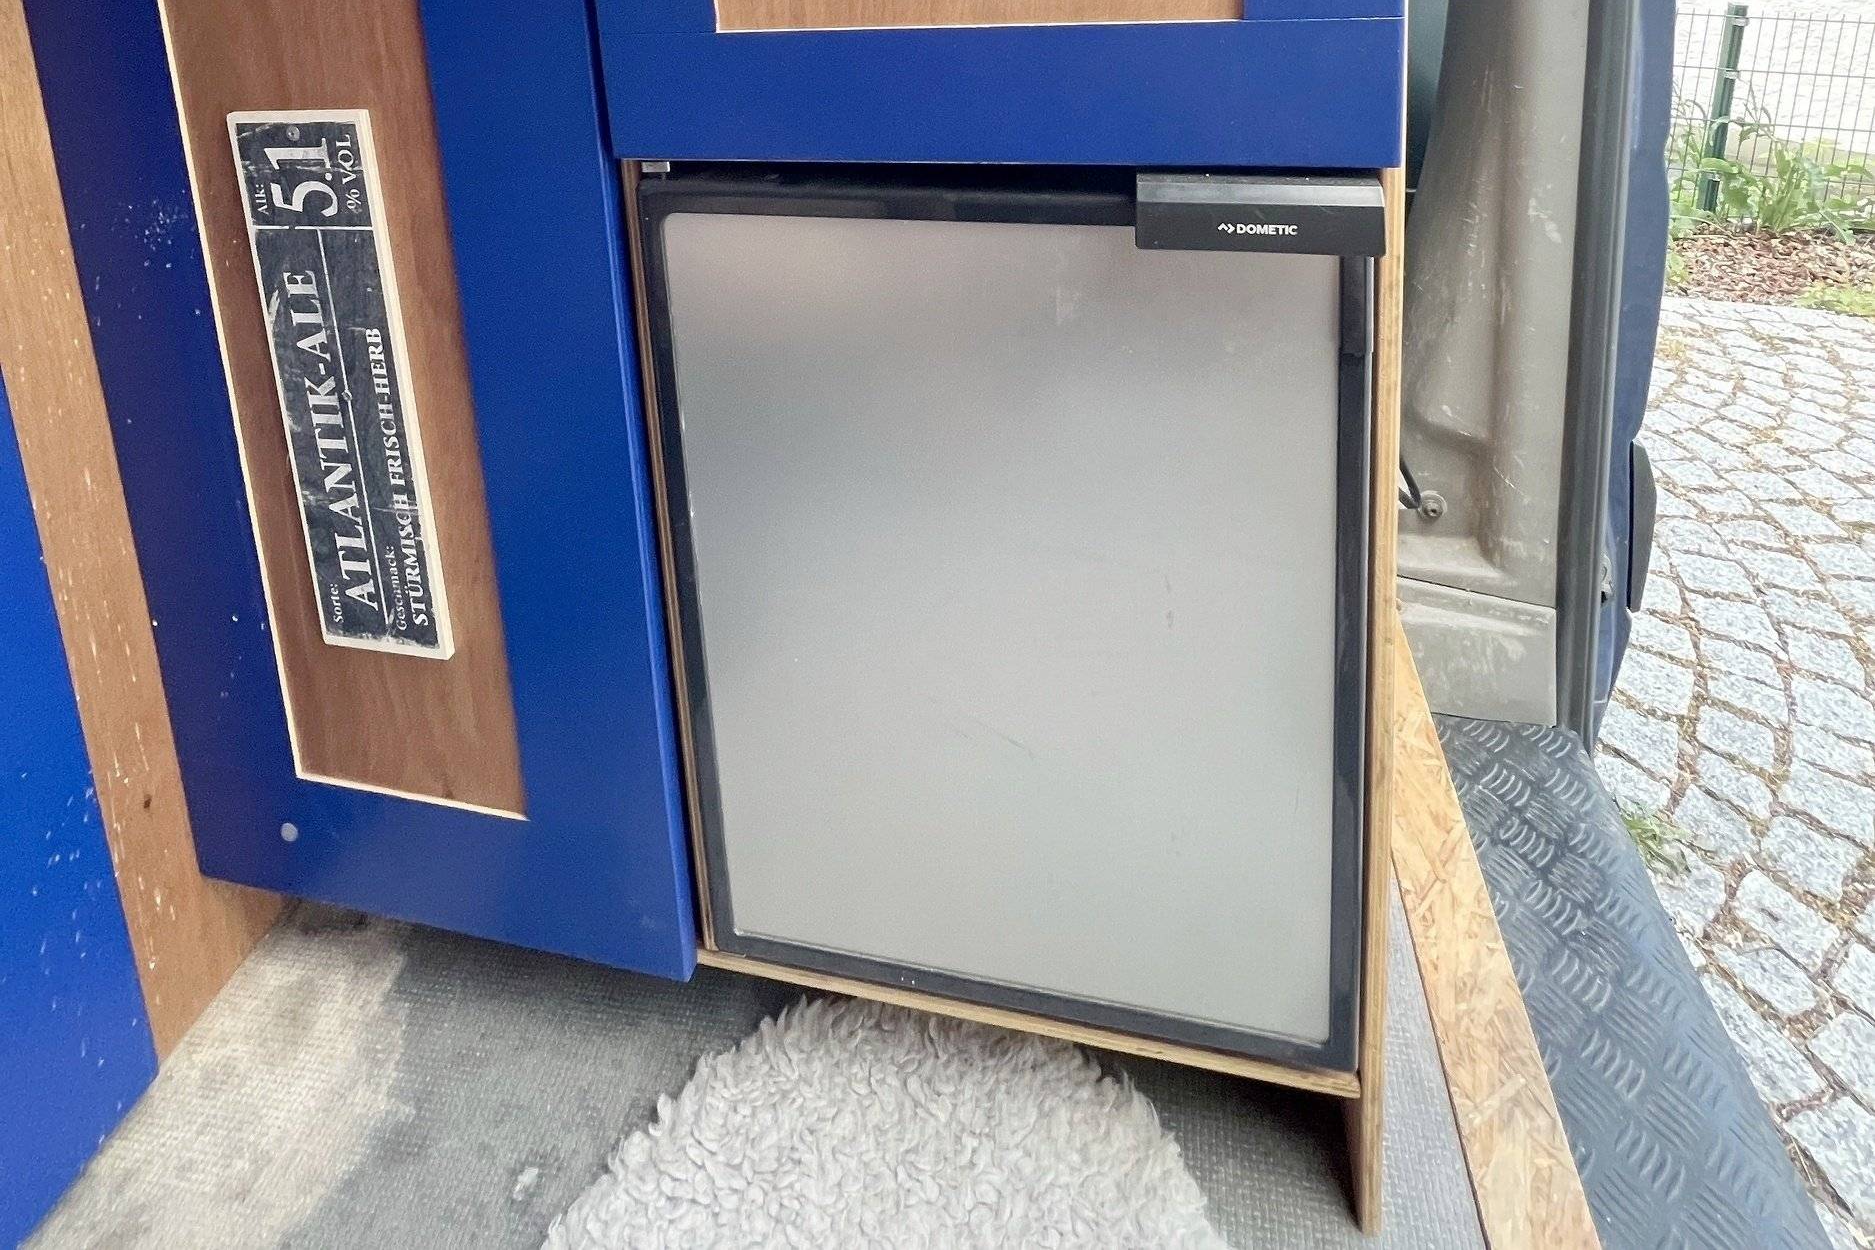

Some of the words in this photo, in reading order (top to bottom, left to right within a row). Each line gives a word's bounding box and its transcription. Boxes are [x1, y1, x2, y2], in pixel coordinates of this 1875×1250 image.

[264, 137, 338, 217] 5.1
[336, 133, 359, 184] VOL
[255, 184, 269, 215] Alk:
[1236, 223, 1298, 235] DOMETIC
[366, 328, 405, 487] FRISCH-HERB
[283, 270, 379, 611] ATLANTIK-ALE
[393, 494, 428, 626] STÜRMISCH
[330, 583, 344, 623] Sorte:
